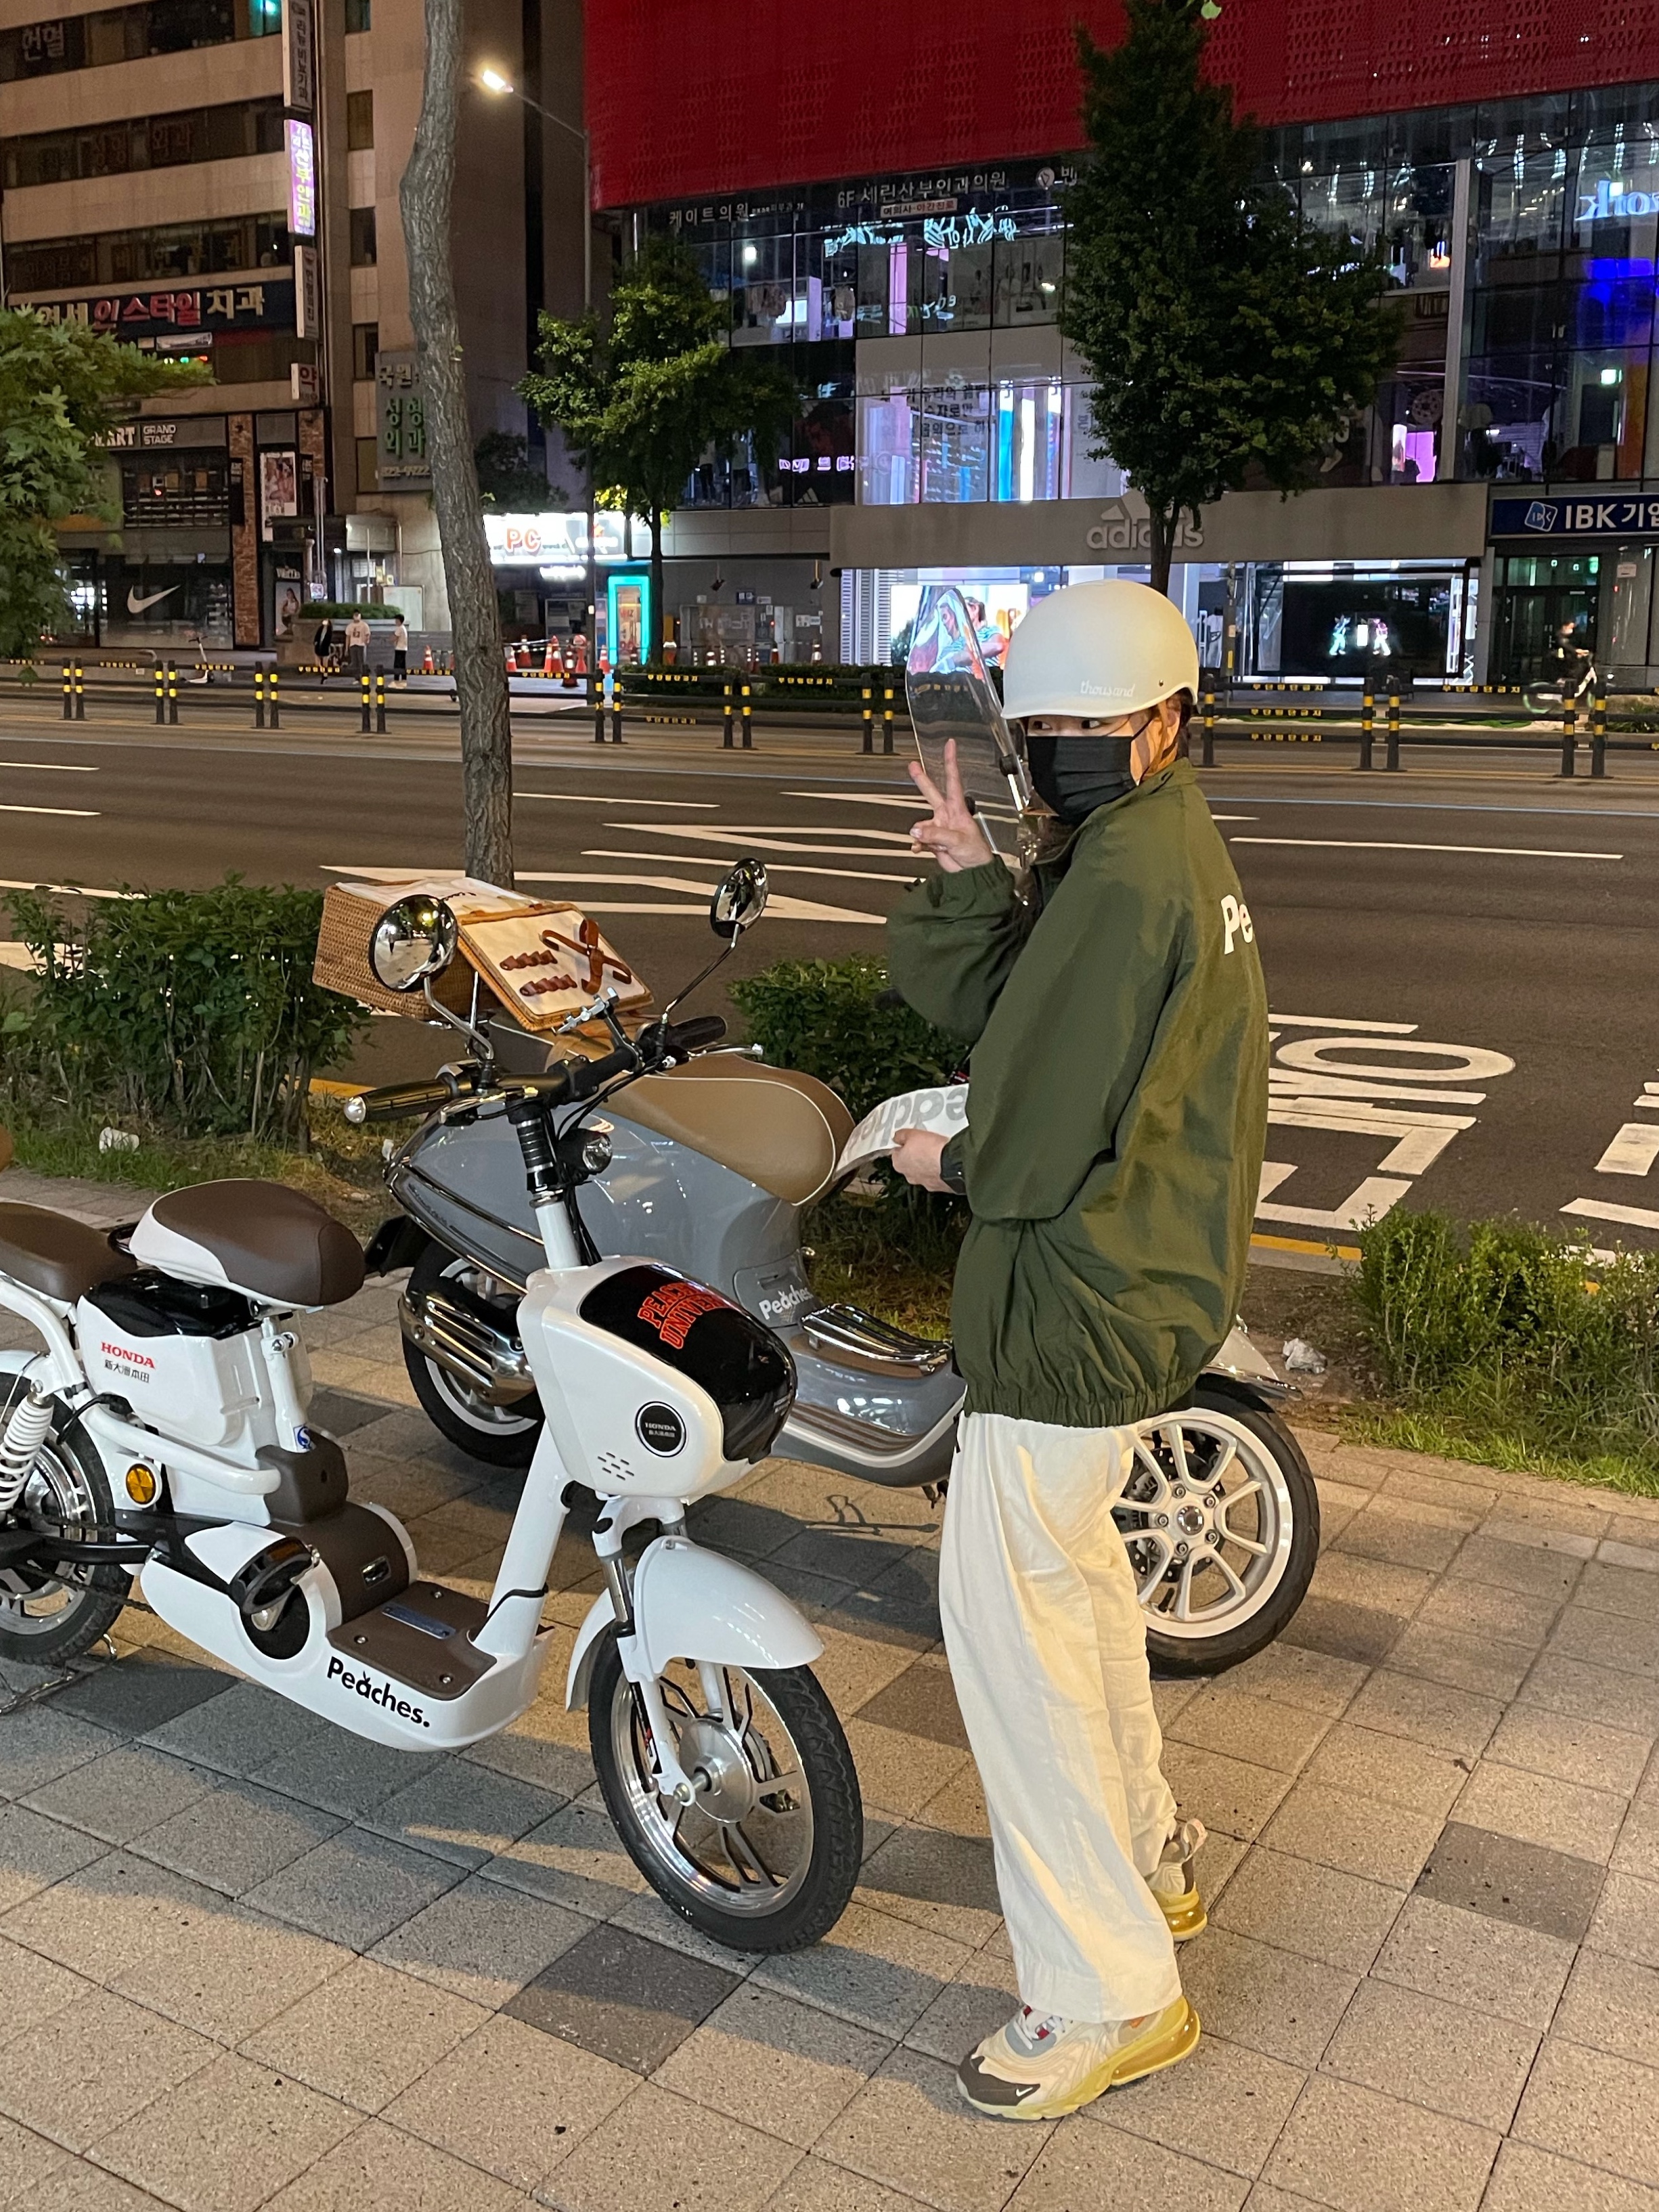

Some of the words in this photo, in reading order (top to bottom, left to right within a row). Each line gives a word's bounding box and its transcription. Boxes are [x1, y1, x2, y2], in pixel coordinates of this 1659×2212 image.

[837, 190, 855, 208] 6F
[860, 171, 1008, 205] 세린산부인과의원
[669, 202, 749, 228] 케이트의원
[206, 286, 265, 319] 치과
[384, 398, 424, 427] 성형
[143, 424, 177, 435] GRAND
[143, 435, 174, 445] STAGE
[384, 428, 426, 459] 외과
[1565, 504, 1618, 529] IBK
[506, 527, 541, 551] PC
[1080, 679, 1136, 698] thousand
[101, 1341, 156, 1369] HONDA
[644, 1422, 676, 1432] HONDA
[326, 1656, 430, 1728] Peaches.
